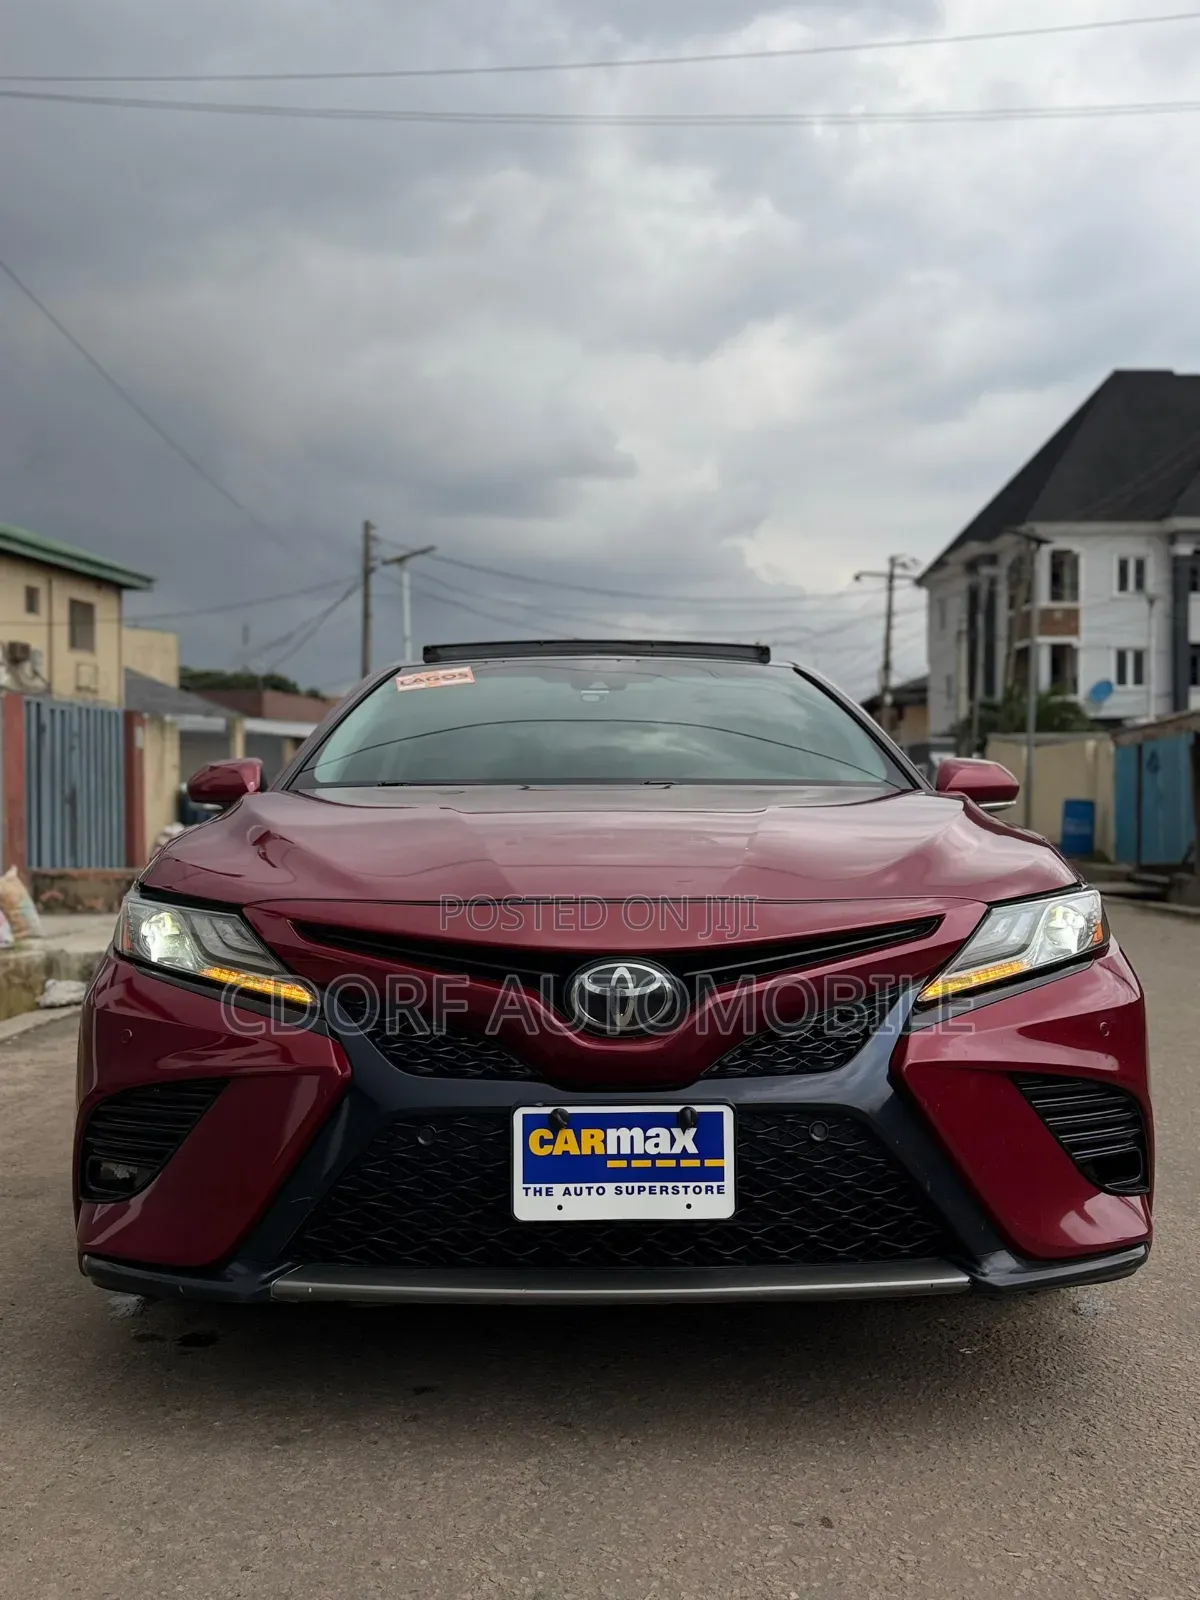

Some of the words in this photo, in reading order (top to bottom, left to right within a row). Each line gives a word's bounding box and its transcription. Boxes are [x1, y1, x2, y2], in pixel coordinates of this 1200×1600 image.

[522, 1186, 554, 1197] THE
[562, 1186, 606, 1197] AUTO
[614, 1184, 726, 1196] SUPERSTORE
